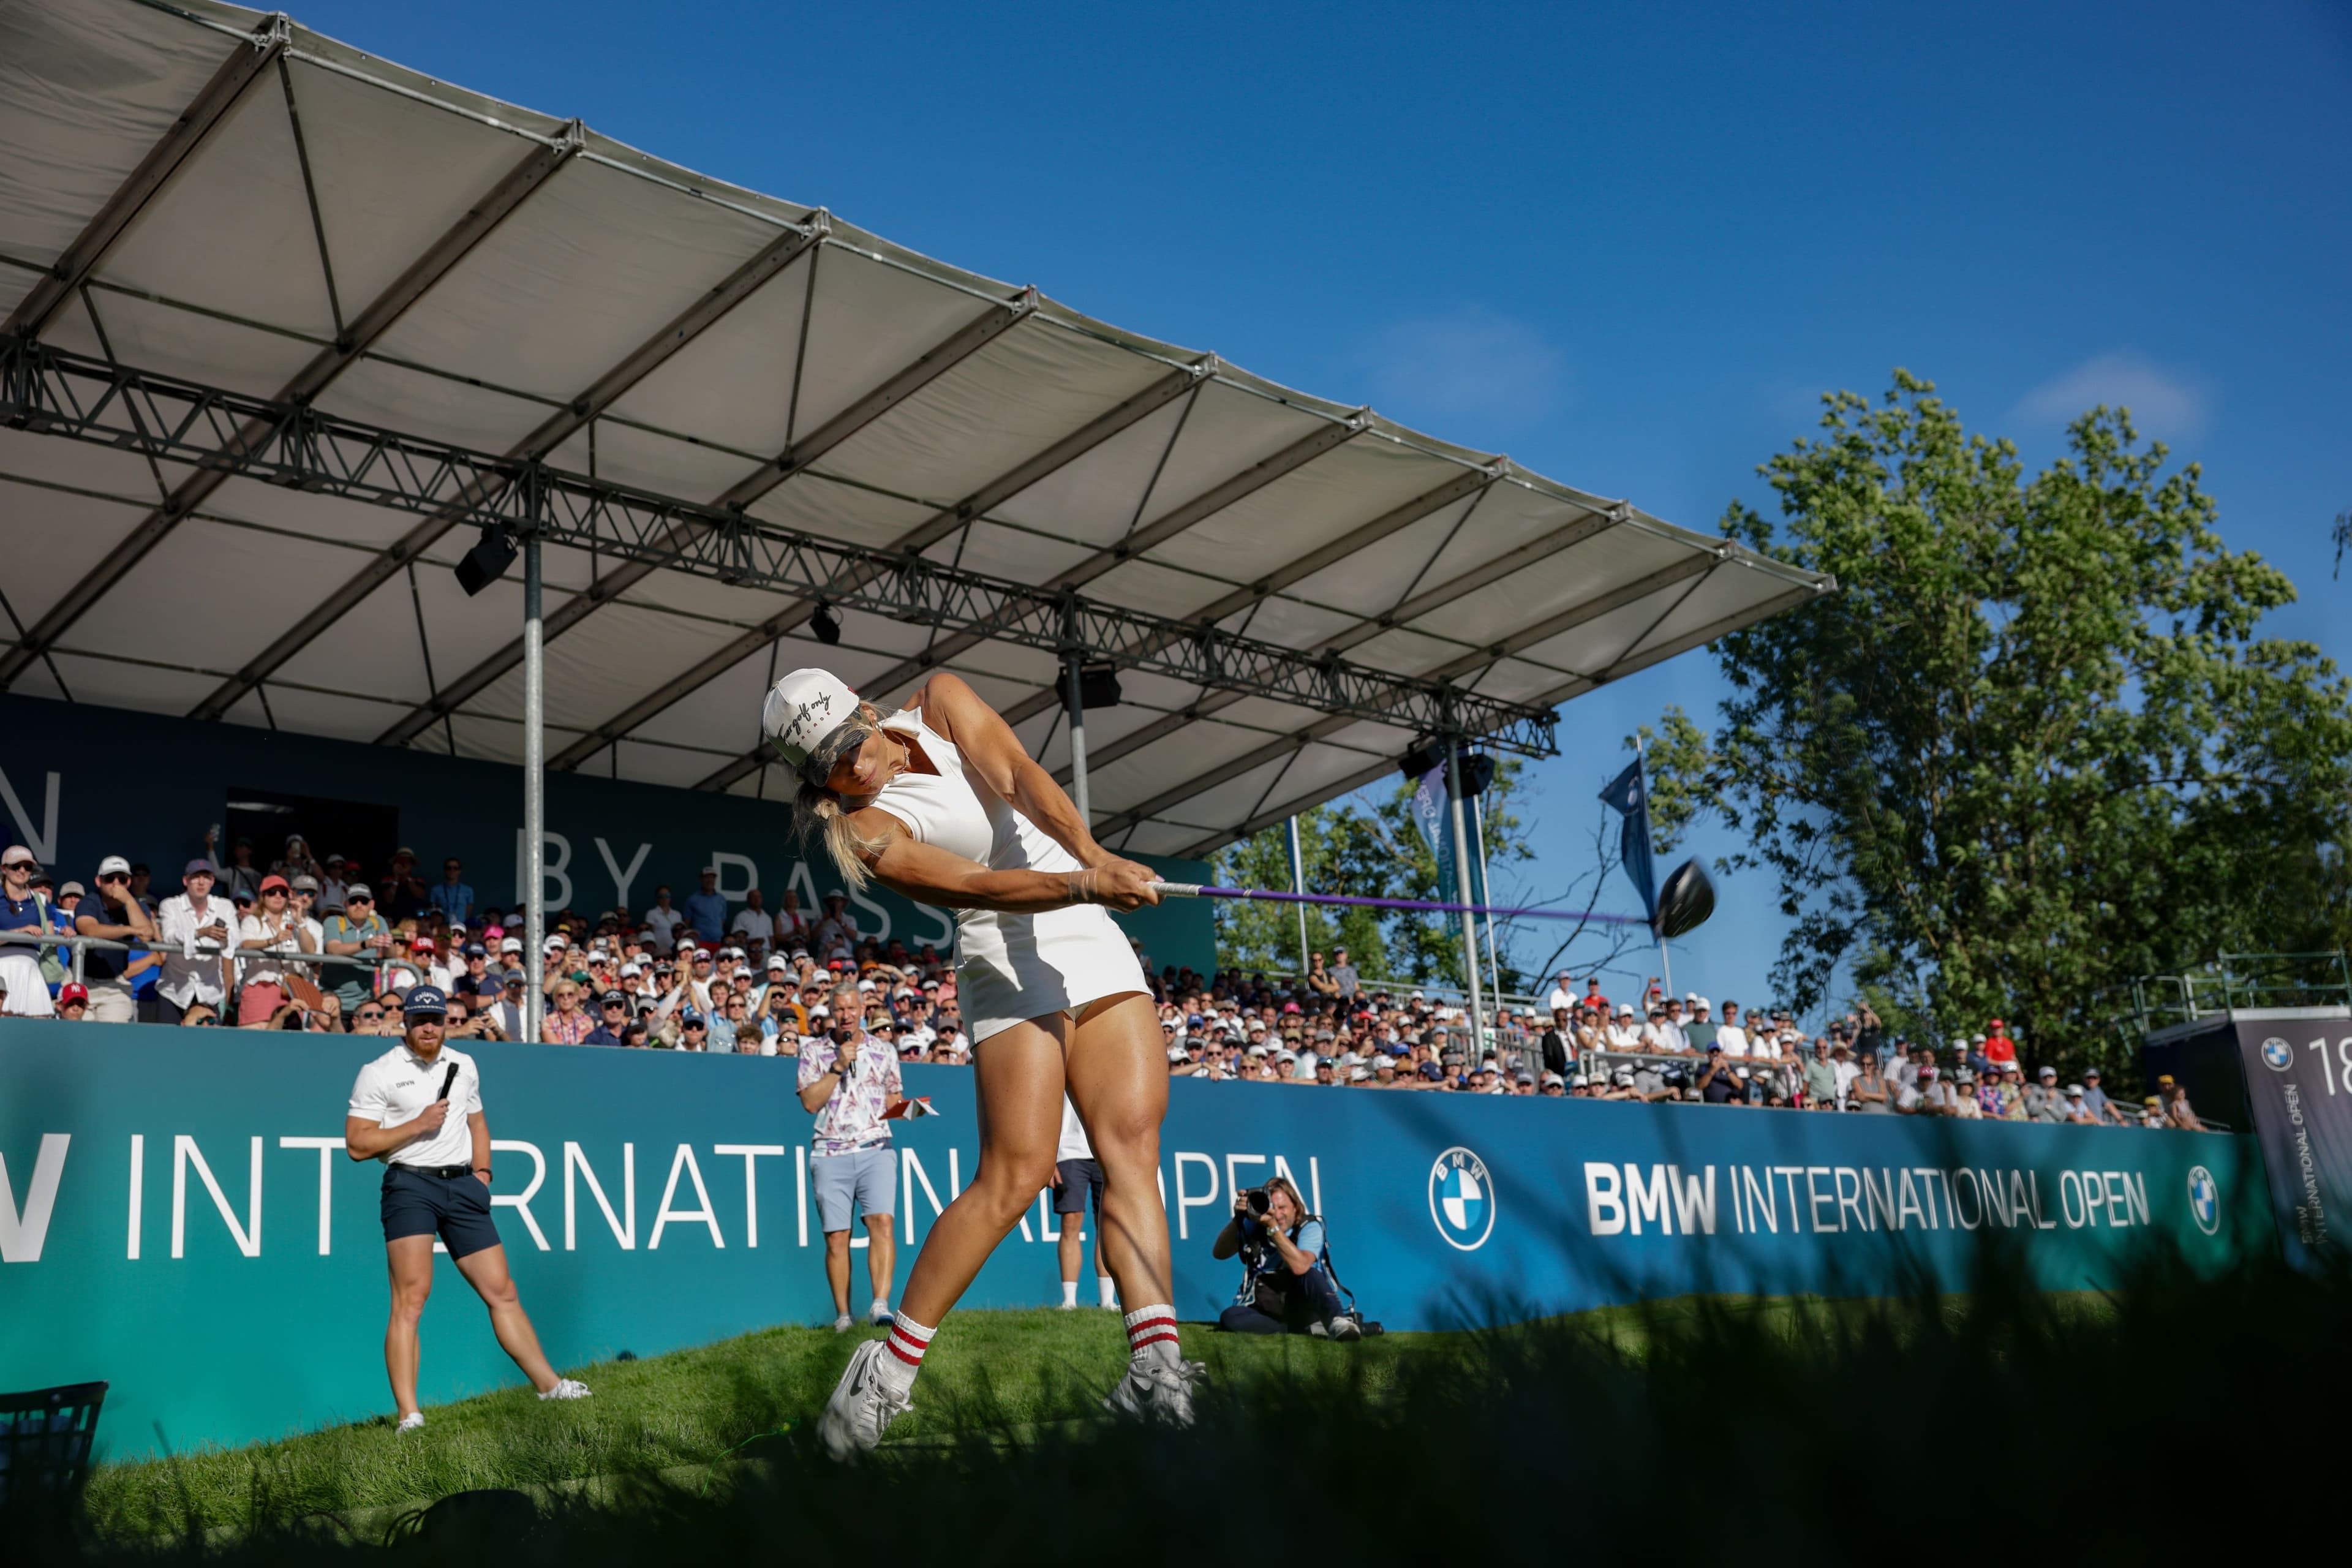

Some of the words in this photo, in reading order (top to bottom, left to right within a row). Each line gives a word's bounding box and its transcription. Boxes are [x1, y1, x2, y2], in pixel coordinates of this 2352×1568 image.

[811, 692, 831, 711] only
[516, 828, 653, 911] BY
[2283, 1084, 2304, 1126] OPEN
[1436, 1152, 1483, 1182] BMW
[127, 1134, 1087, 1260] INTRNATINL
[1156, 1152, 1322, 1240] PEN
[1584, 1161, 1715, 1235] BMW
[1729, 1165, 2057, 1234] INTERNATIONAL
[2060, 1169, 2150, 1229] OPEN
